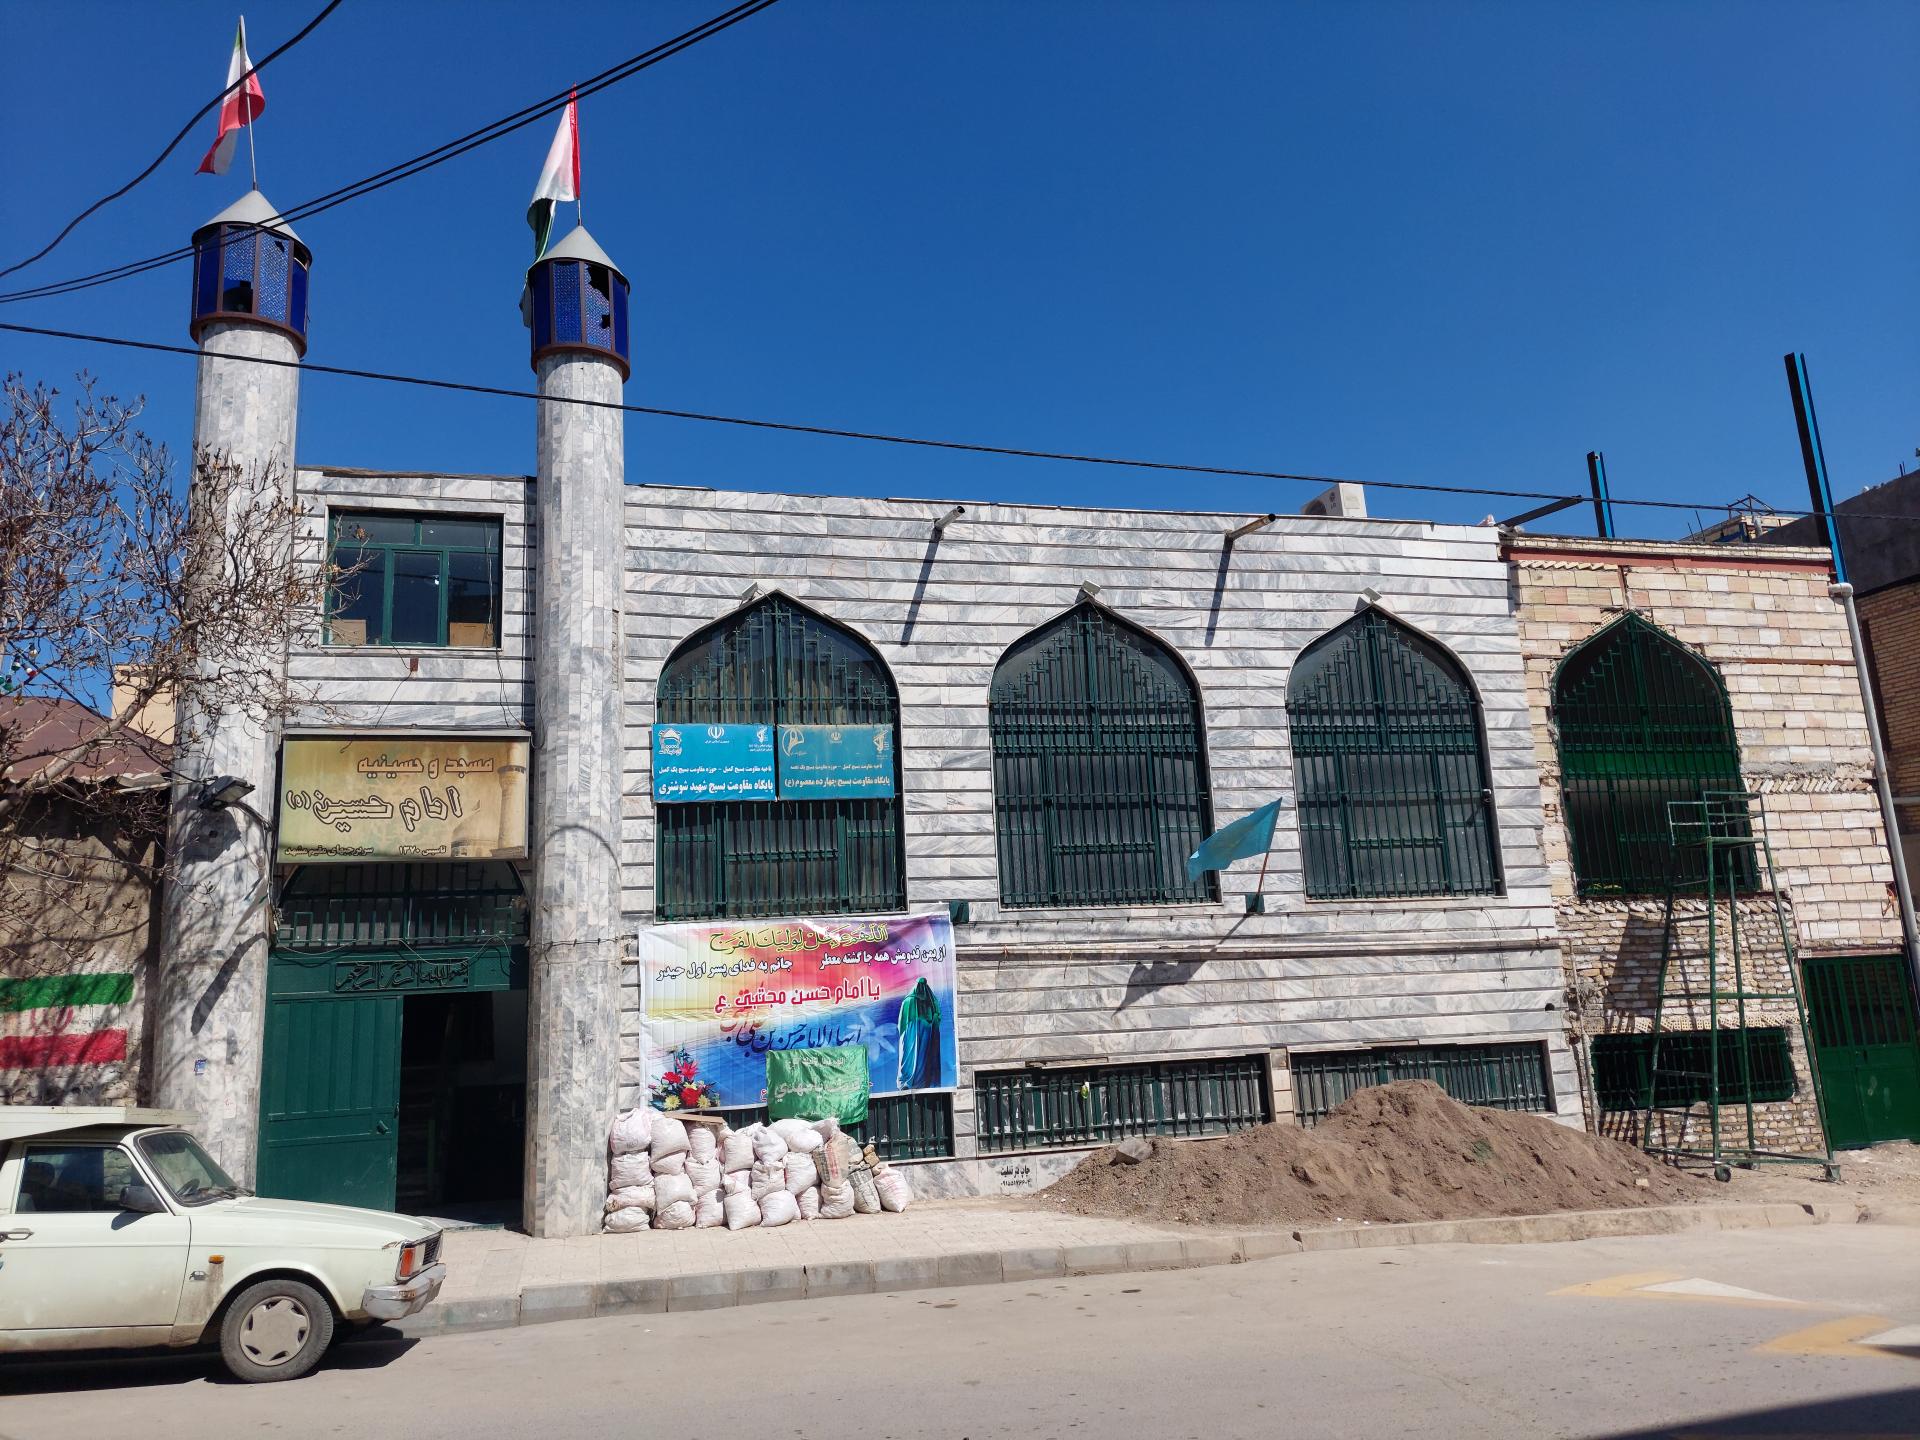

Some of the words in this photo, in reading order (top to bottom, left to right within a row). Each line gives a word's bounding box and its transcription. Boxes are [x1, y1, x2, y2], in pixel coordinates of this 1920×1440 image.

[357, 754, 424, 779] حسینیه
[428, 758, 440, 779] و
[445, 756, 494, 778] مسجد
[670, 766, 678, 774] یک
[690, 766, 706, 774] مقاومت
[706, 766, 716, 774] حوزه
[734, 766, 744, 774] بسیج
[745, 766, 760, 774] مقاومت
[658, 780, 688, 794] شوشتری
[690, 780, 708, 794] شهید
[708, 782, 726, 794] بسیج
[727, 778, 753, 794] مقاومت
[754, 778, 774, 794] پایگاه
[784, 778, 795, 788] (ع)
[794, 778, 815, 788] معصوم
[837, 778, 852, 788] بسیج
[852, 776, 873, 787] مقاومت
[874, 776, 890, 787] پایگاه
[312, 789, 394, 833] حسین
[399, 785, 463, 832] امام
[284, 844, 308, 857] مشهد
[308, 844, 328, 858] مقیم
[398, 845, 421, 856] ۱۳۷۰
[422, 844, 447, 857] تاسیس
[842, 950, 862, 964] گشته
[863, 950, 873, 965] جا
[874, 950, 890, 962] همه
[890, 945, 921, 965] قدومش
[920, 948, 938, 963] یمن
[938, 944, 947, 962] از
[728, 958, 757, 976] فدای
[757, 960, 768, 974] به
[770, 956, 794, 974] جانم
[819, 952, 842, 970] معطر
[656, 965, 686, 982] حیدر
[686, 961, 706, 979] اول
[707, 963, 728, 979] پسر
[790, 987, 832, 1006] حسن
[834, 978, 864, 1004] امام
[866, 976, 881, 1002] یا
[735, 990, 787, 1011] مجتبی
